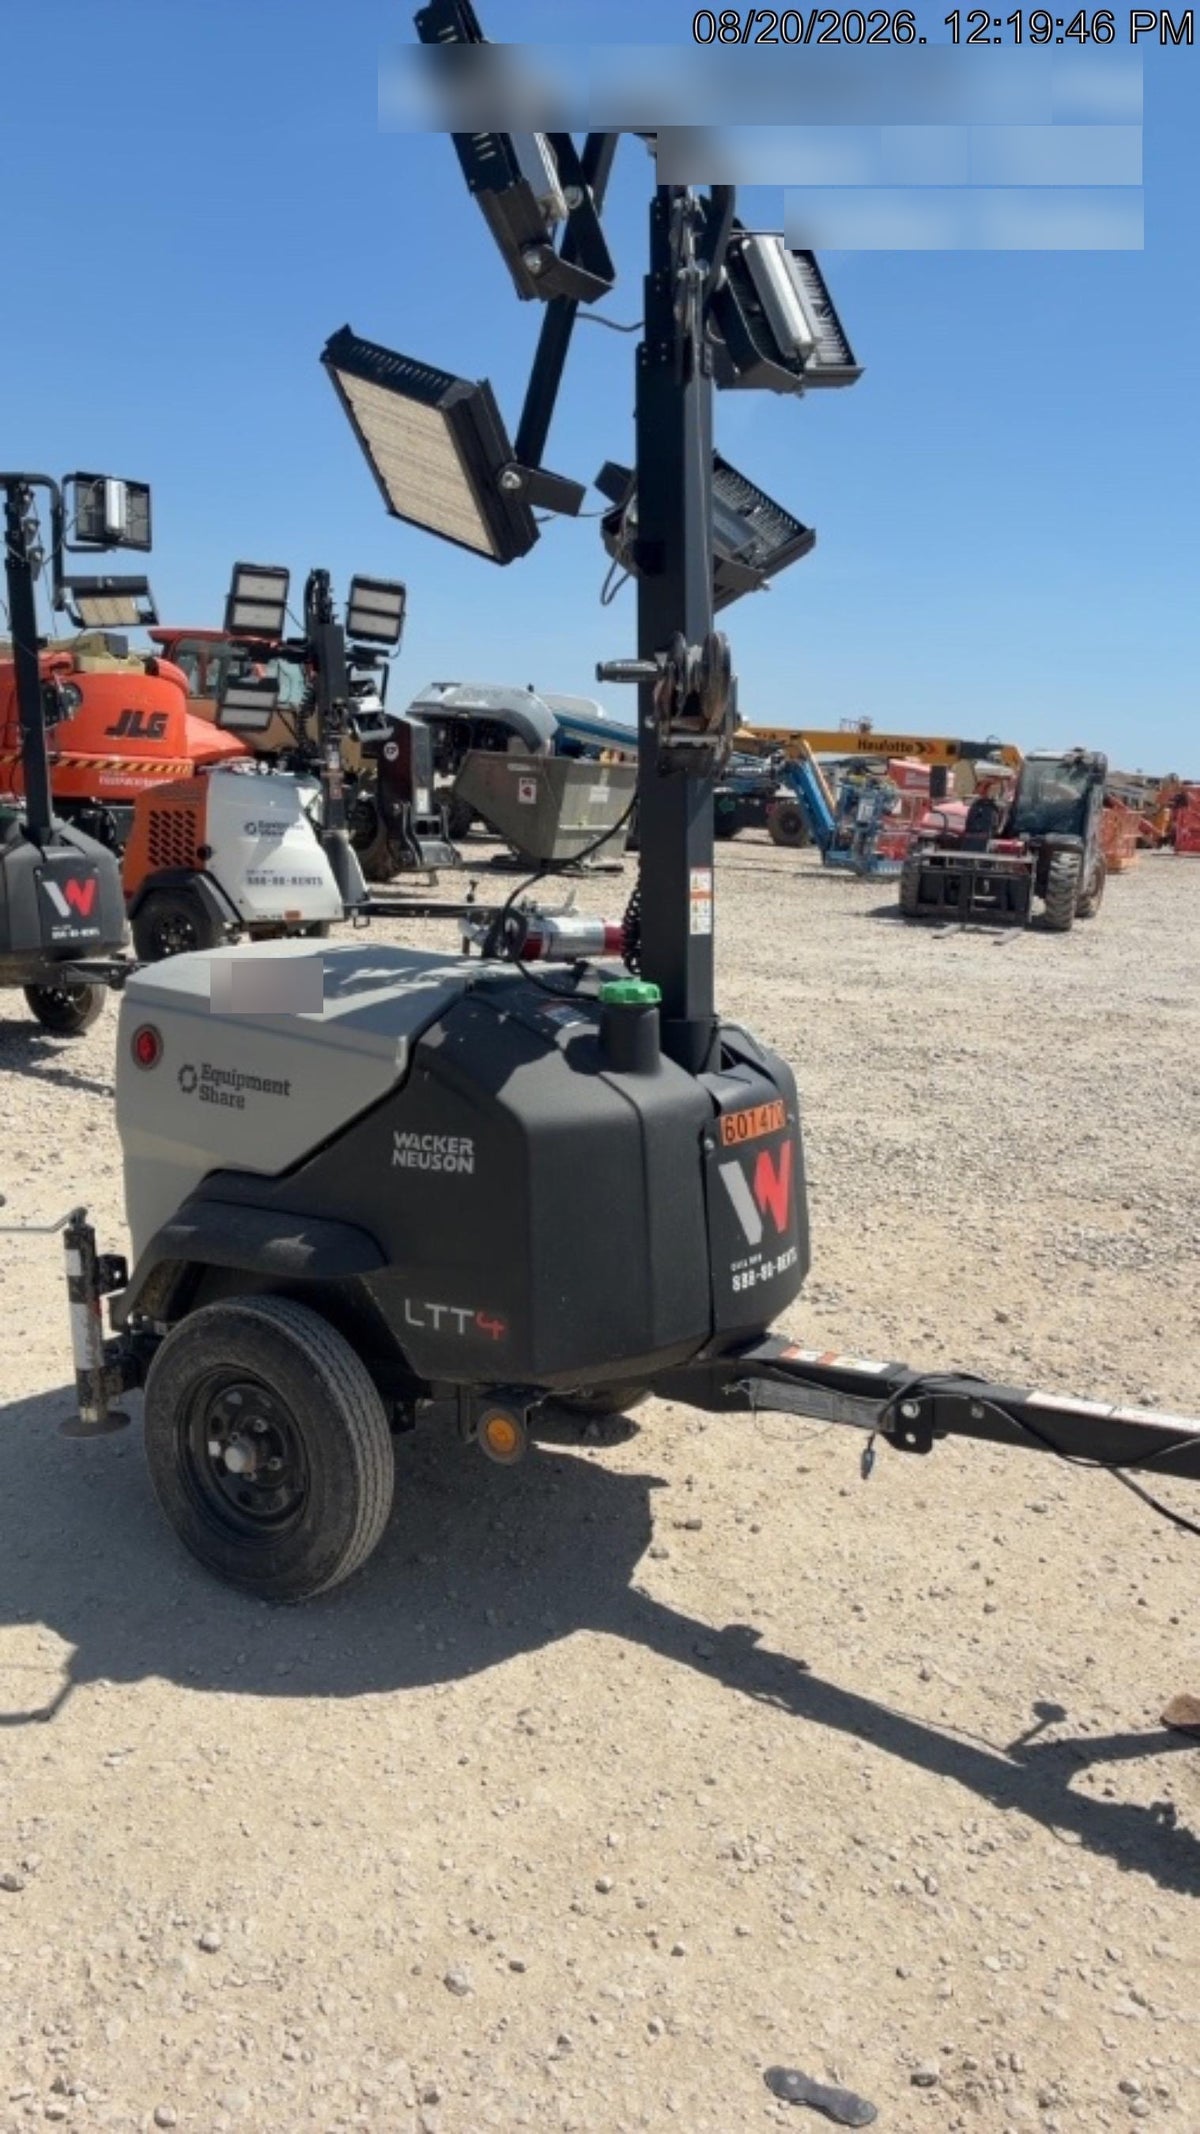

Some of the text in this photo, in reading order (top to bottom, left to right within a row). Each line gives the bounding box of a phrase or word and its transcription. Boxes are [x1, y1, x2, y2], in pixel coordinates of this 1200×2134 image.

[103, 709, 169, 738] JLG
[858, 738, 914, 754] Haulotte
[200, 1062, 292, 1097] Equipment
[199, 1083, 246, 1110] Share
[393, 1130, 475, 1156] WACKER
[392, 1149, 475, 1175] NEUSON
[404, 1298, 506, 1341] LTT4
